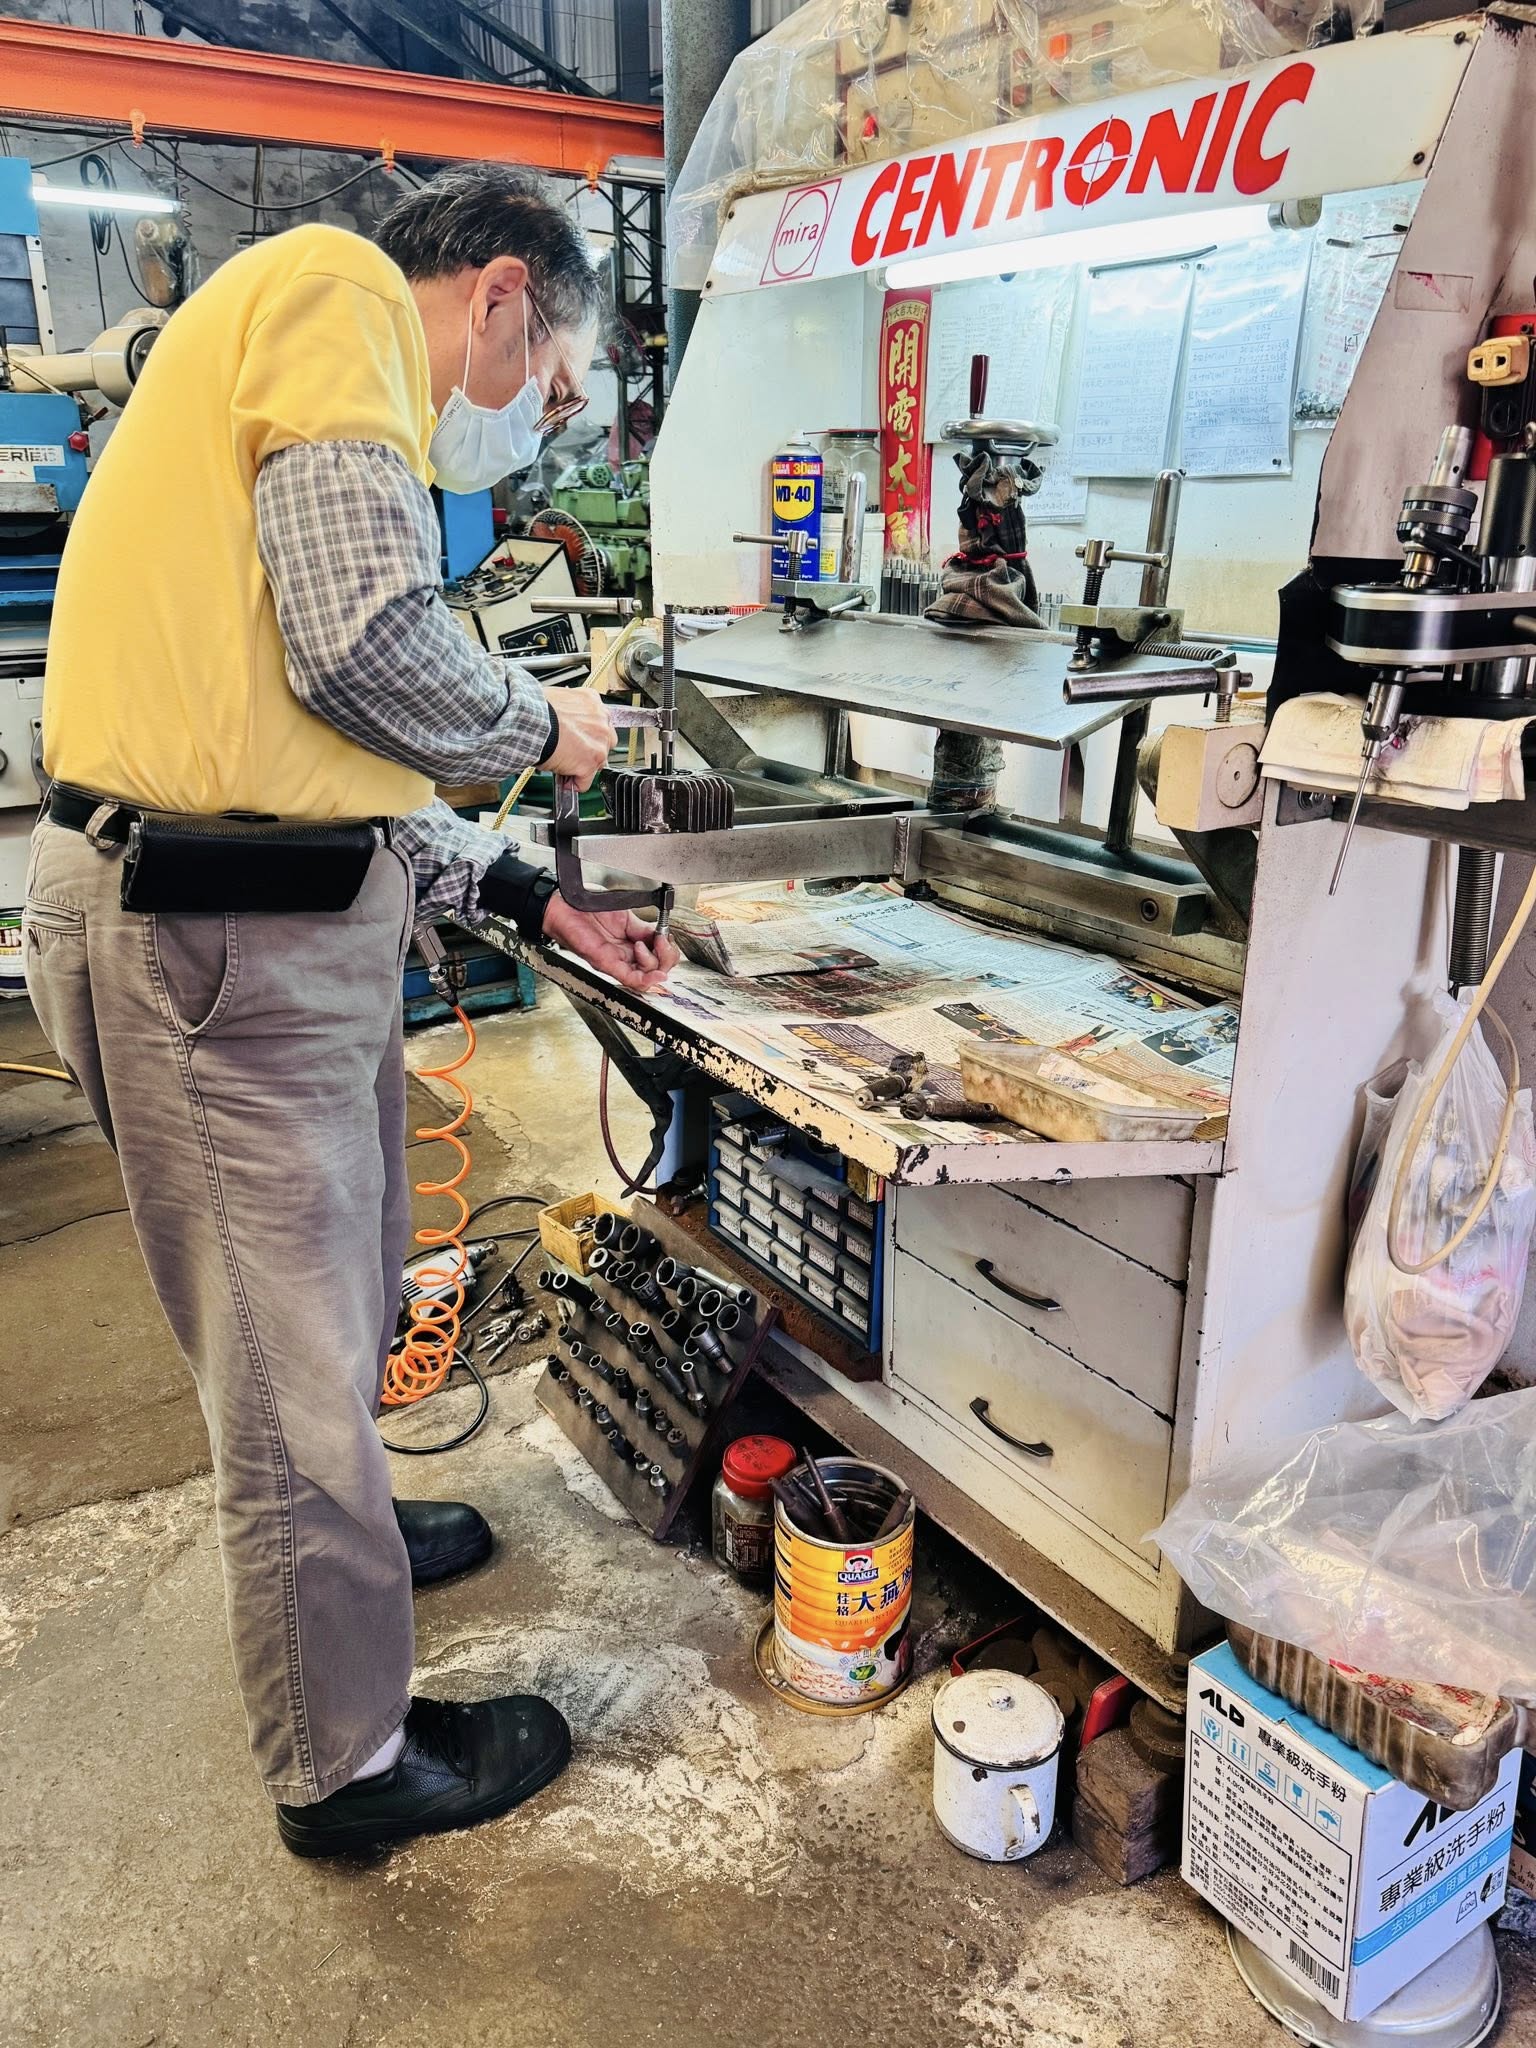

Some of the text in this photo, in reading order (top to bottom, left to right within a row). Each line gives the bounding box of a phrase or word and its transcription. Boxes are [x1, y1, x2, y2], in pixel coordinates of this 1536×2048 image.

[850, 62, 1316, 267] CENTRONIC
[778, 221, 820, 247] mira
[775, 485, 811, 502] WD-40
[838, 1570, 878, 1583] QUAKER
[1199, 1688, 1245, 1728] ALD
[1257, 1726, 1347, 1803] 專業級洗手粉
[1378, 1801, 1506, 1914] 專業級洗手粉
